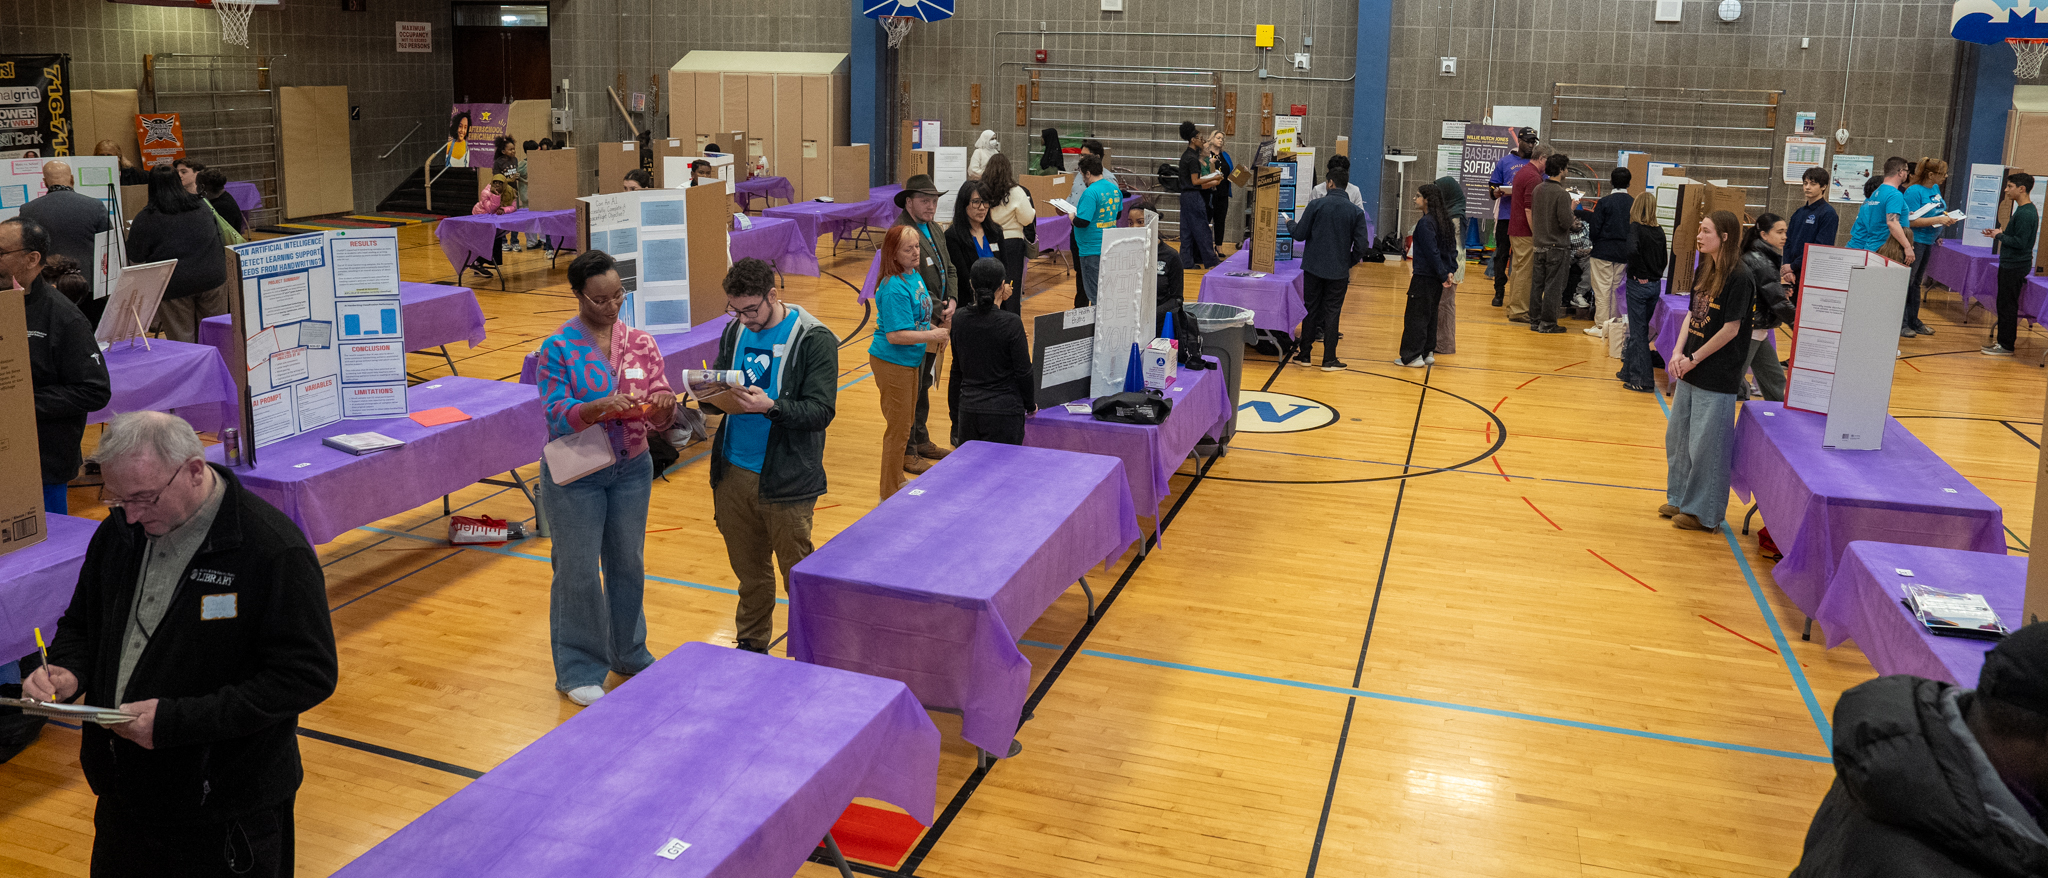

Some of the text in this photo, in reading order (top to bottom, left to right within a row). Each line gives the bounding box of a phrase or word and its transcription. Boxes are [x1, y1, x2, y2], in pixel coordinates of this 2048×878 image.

[12, 119, 35, 127] WBLK
[15, 130, 44, 146] Bank
[236, 237, 322, 256] CAN ARTIFICIAL INTELLIGENCE
[241, 248, 320, 267] DETECT LEARNING SUPPORT
[1107, 249, 1144, 272] THIS
[261, 264, 279, 274] FROM
[279, 258, 322, 271] HANDWRITING?
[1102, 297, 1129, 320] BE
[1100, 326, 1135, 353] YOU
[305, 379, 332, 392] VARIABLES
[252, 393, 282, 407] AI PROMPT
[196, 572, 235, 586] LIBRARY
[667, 842, 685, 855] G17
